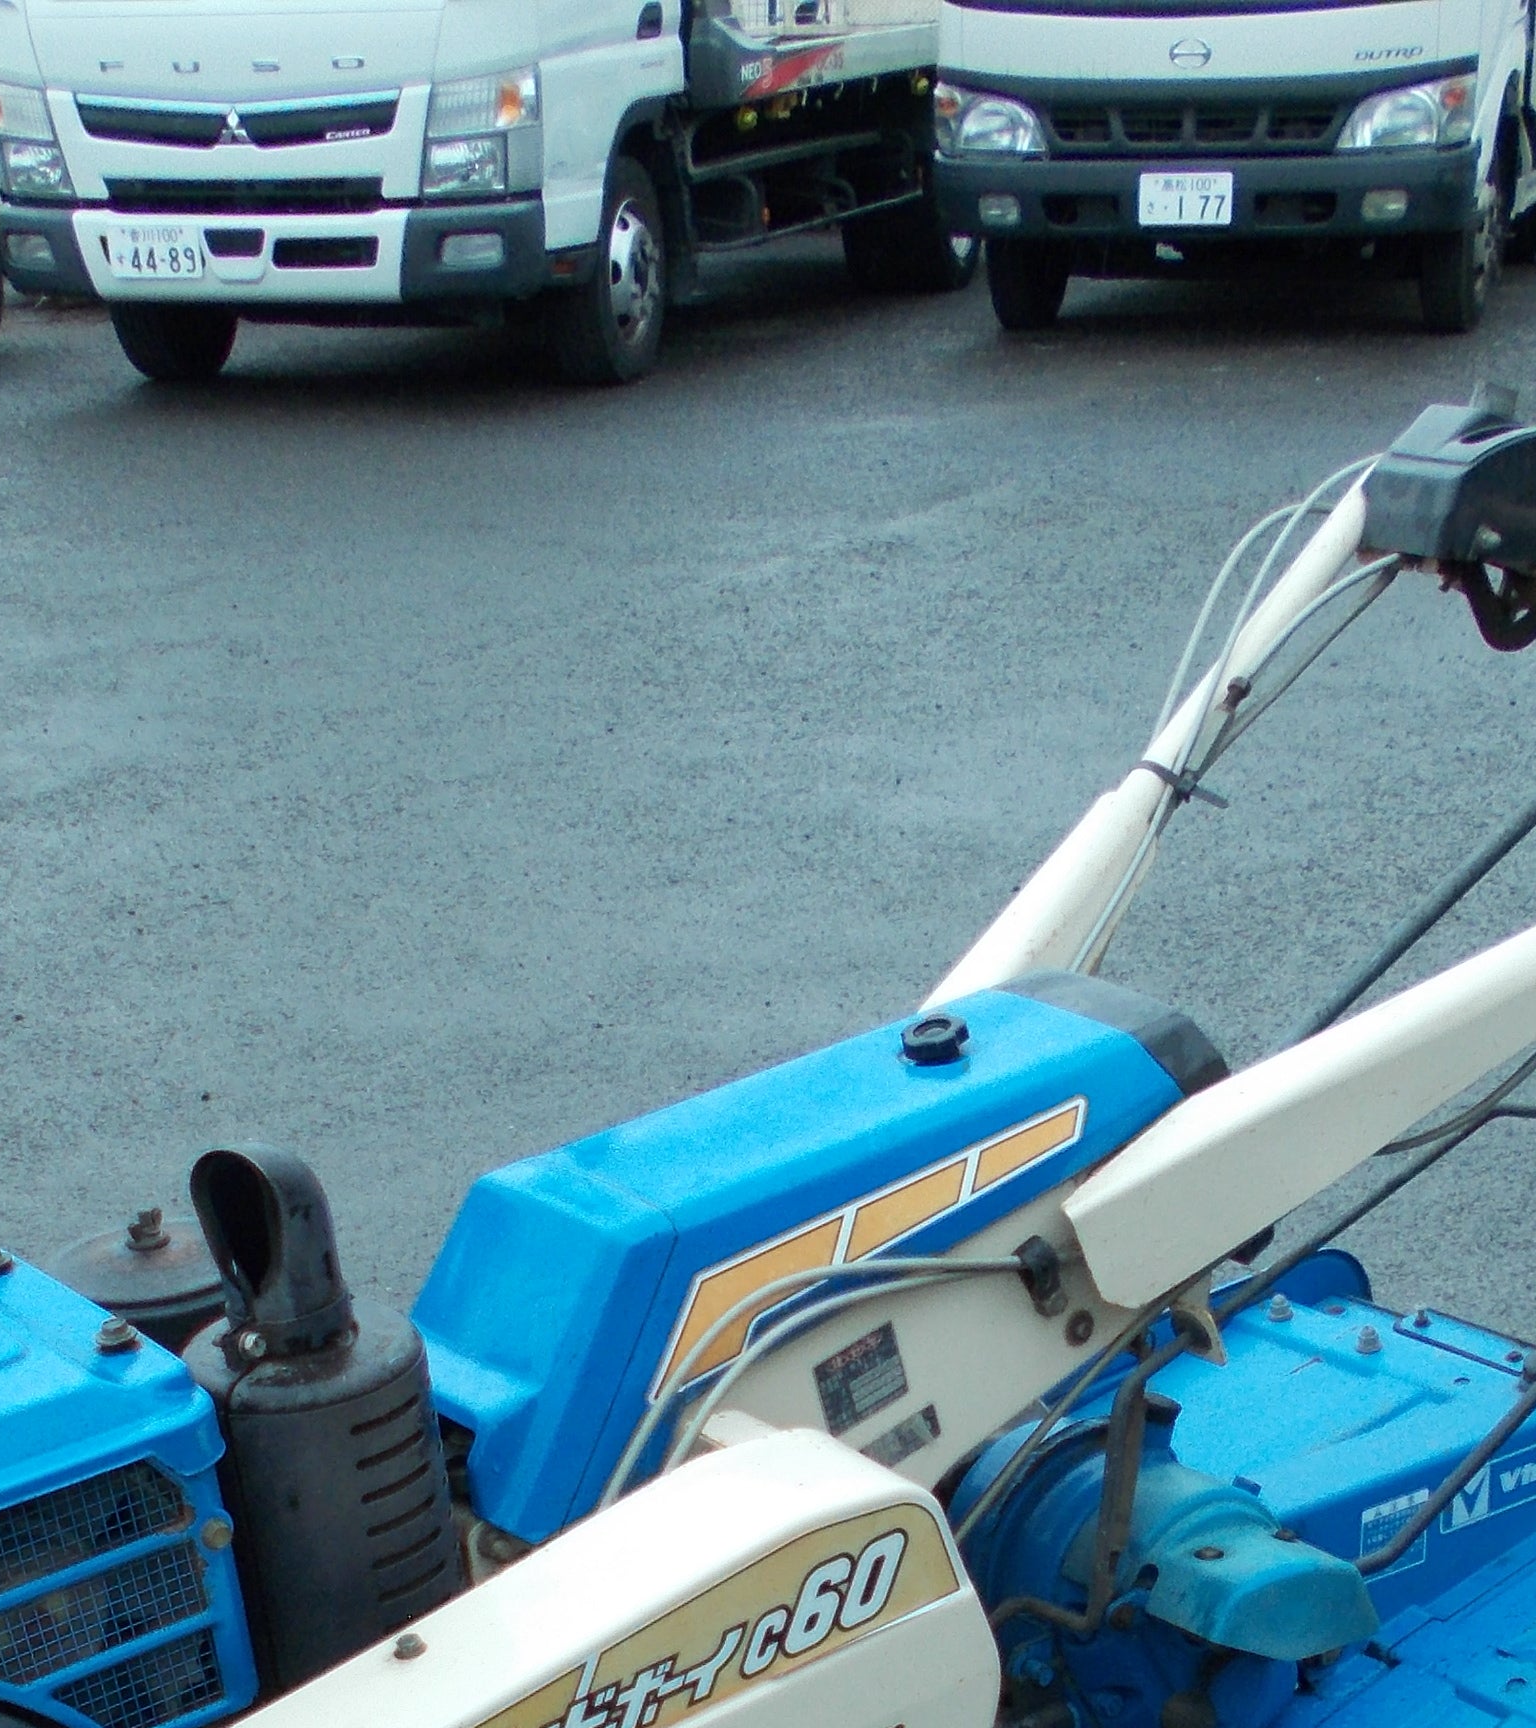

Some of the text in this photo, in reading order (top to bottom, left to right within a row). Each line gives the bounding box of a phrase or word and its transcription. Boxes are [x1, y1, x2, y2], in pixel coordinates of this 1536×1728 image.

[1354, 46, 1423, 60] DUTRO
[99, 56, 365, 73] FUSO
[131, 246, 196, 273] 44-89
